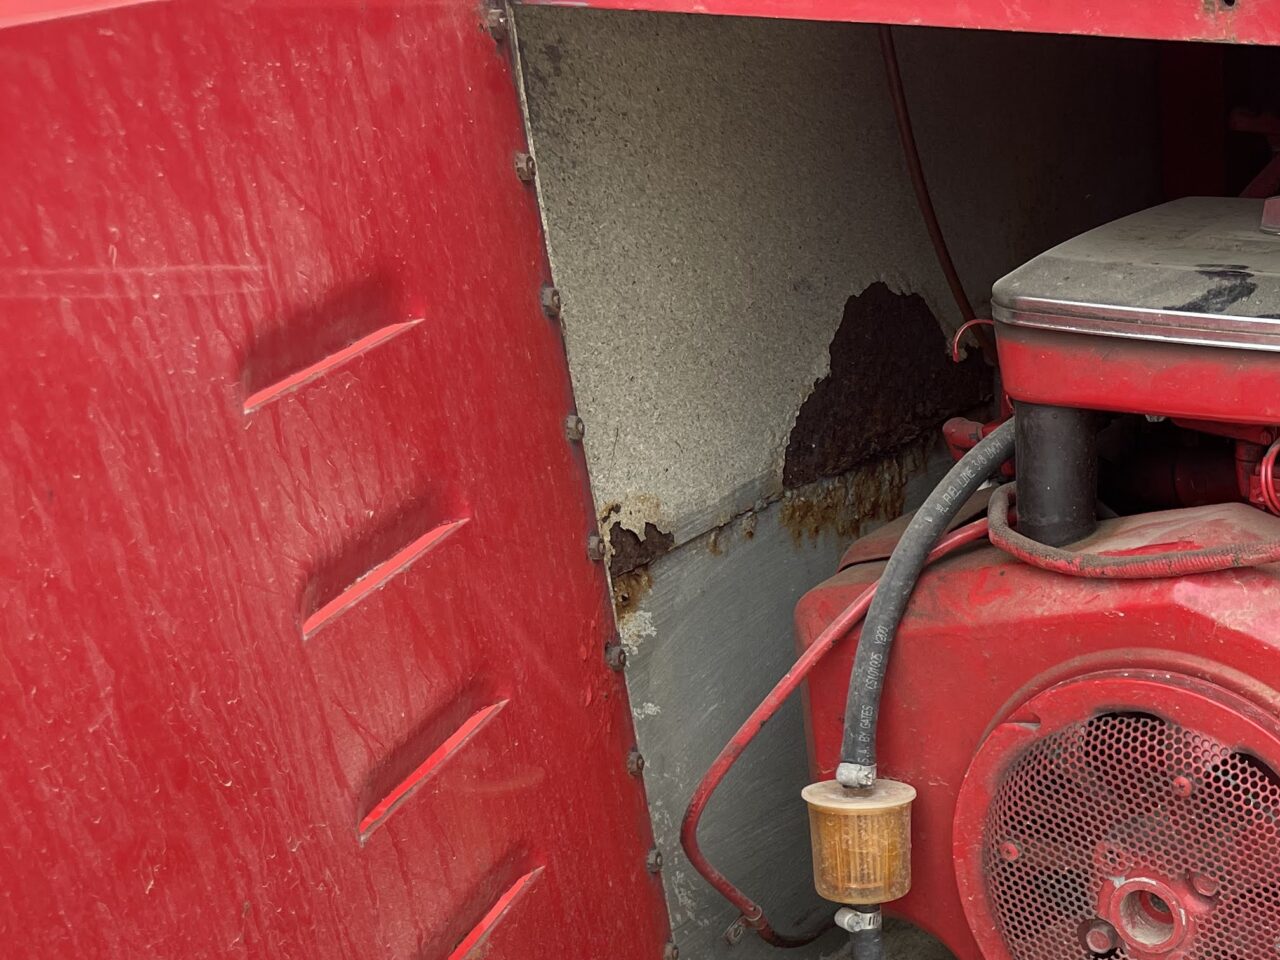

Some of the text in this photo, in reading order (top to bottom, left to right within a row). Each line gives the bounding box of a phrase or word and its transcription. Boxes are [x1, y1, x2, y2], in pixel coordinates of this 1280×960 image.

[957, 466, 977, 488] LINE
[971, 454, 987, 471] 3/8
[860, 705, 874, 729] GATES
[859, 731, 870, 743] BY
